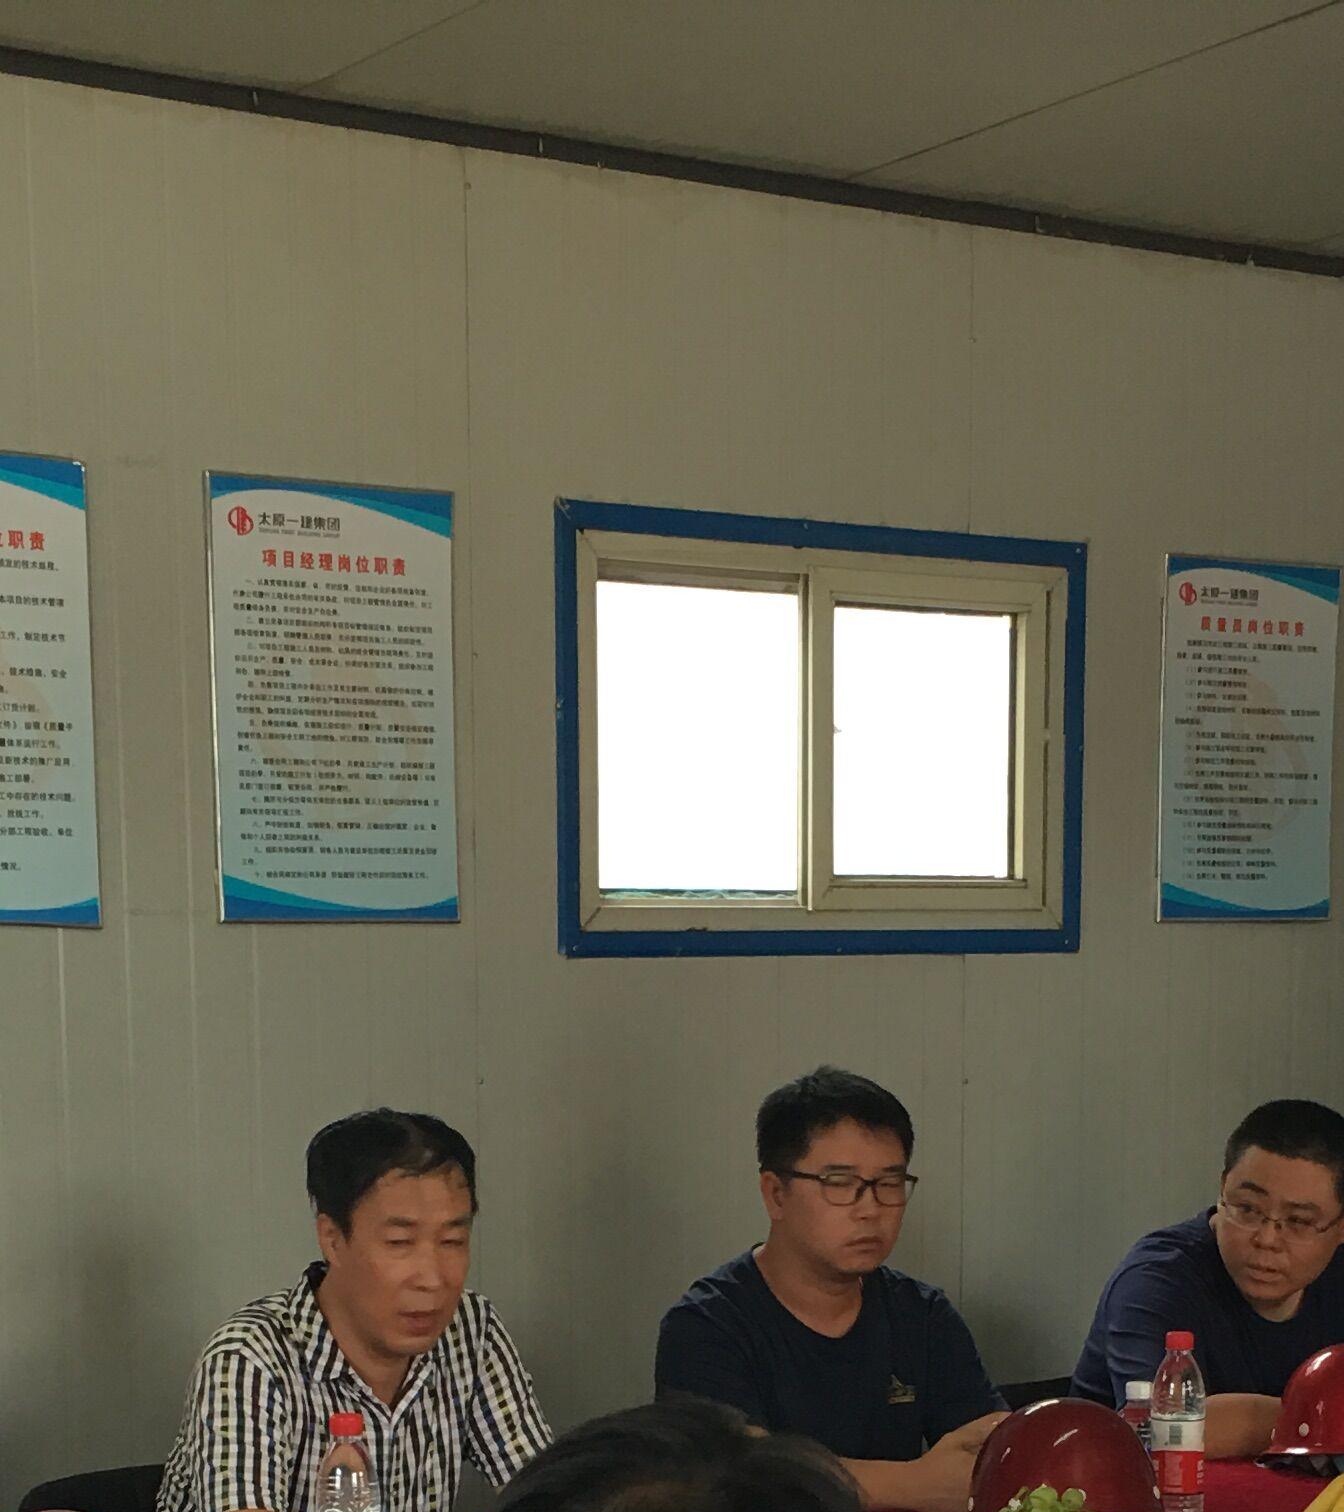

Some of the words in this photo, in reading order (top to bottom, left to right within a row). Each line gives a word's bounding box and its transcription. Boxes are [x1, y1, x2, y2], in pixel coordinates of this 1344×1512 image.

[258, 512, 340, 531] 太原一建集团
[262, 549, 406, 576] 项目经理岗位职责
